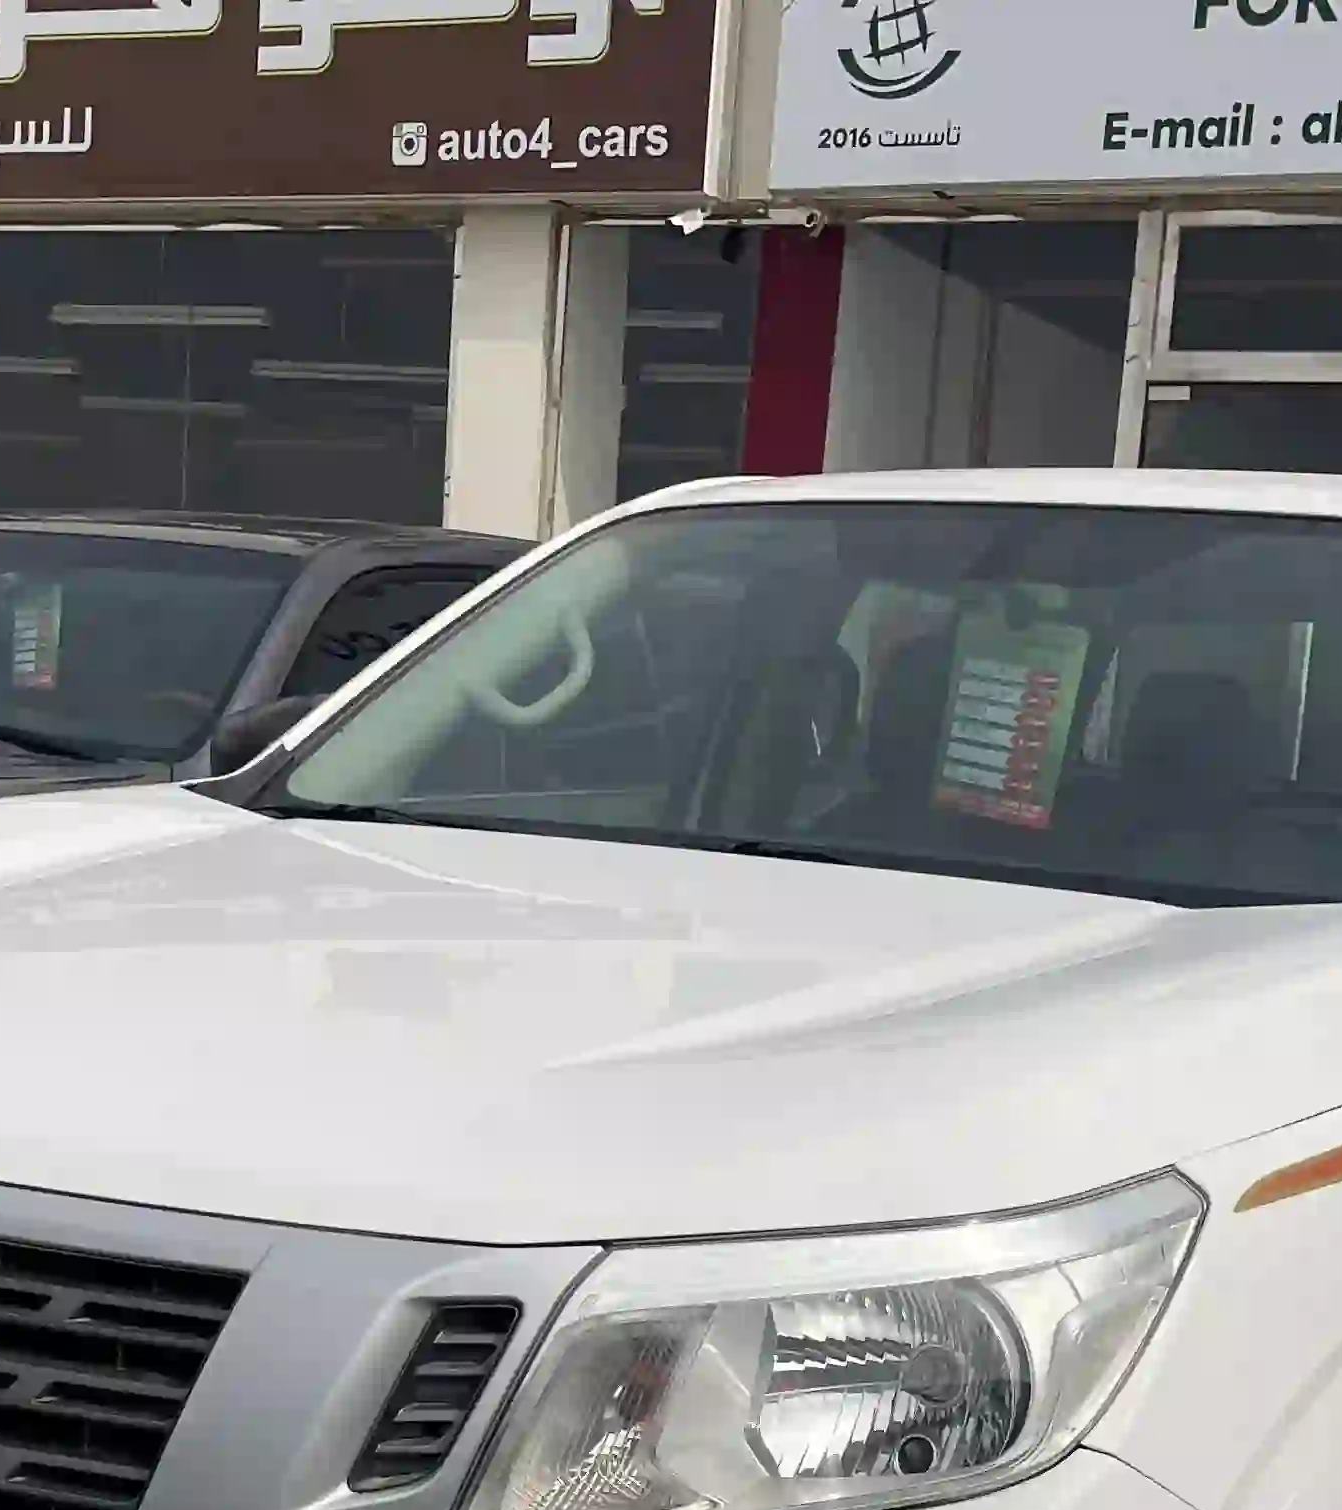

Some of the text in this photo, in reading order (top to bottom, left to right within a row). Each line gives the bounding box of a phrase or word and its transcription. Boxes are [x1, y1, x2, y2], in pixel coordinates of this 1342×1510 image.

[437, 118, 669, 168] auto4_cars
[818, 128, 871, 148] 2016
[1102, 102, 1254, 150] E-mail
